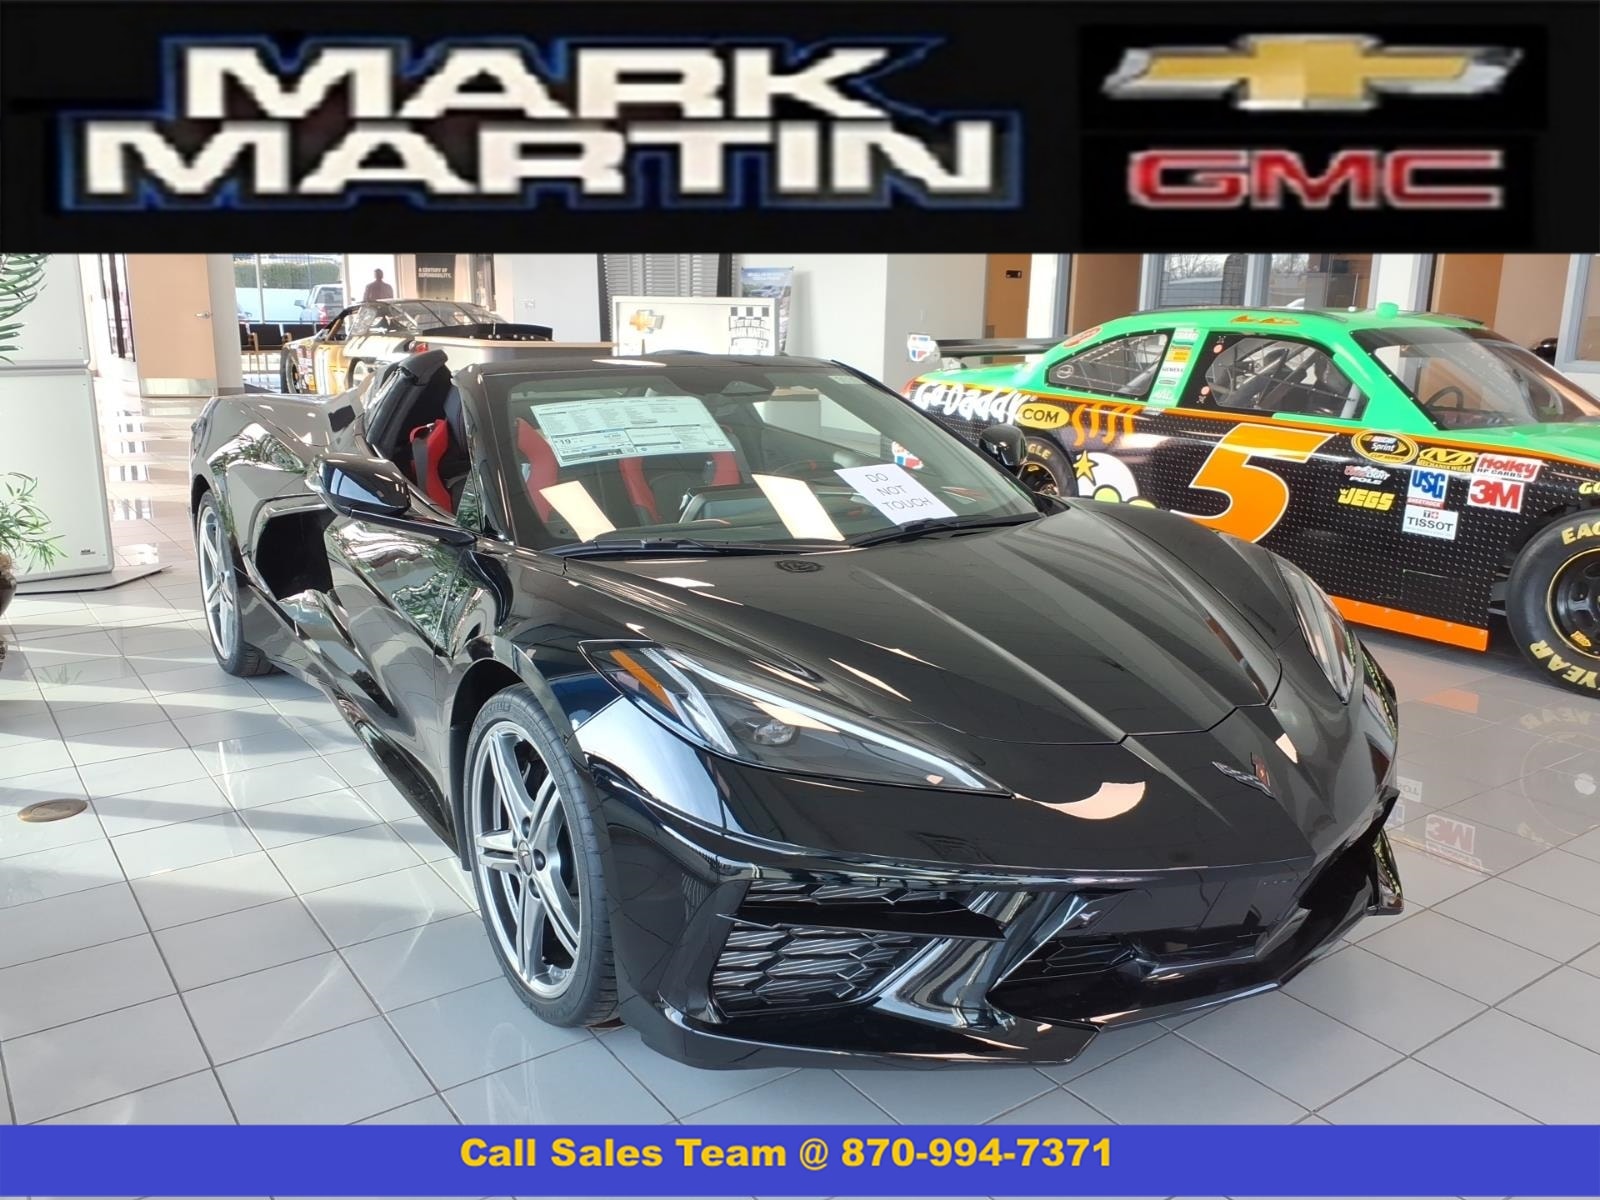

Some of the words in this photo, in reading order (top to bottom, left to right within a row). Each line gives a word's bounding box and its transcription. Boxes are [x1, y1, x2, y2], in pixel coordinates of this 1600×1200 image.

[1022, 407, 1060, 424] COM
[1370, 442, 1397, 453] Sprint
[1479, 457, 1538, 480] Holley
[865, 472, 889, 483] DO
[1169, 422, 1339, 544] 5
[1411, 469, 1446, 500] USG
[876, 485, 907, 496] NOT
[1337, 487, 1396, 511] JEGS
[1470, 479, 1522, 510] 3M
[882, 497, 934, 511] TOUCH
[1407, 516, 1455, 532] TISSOT
